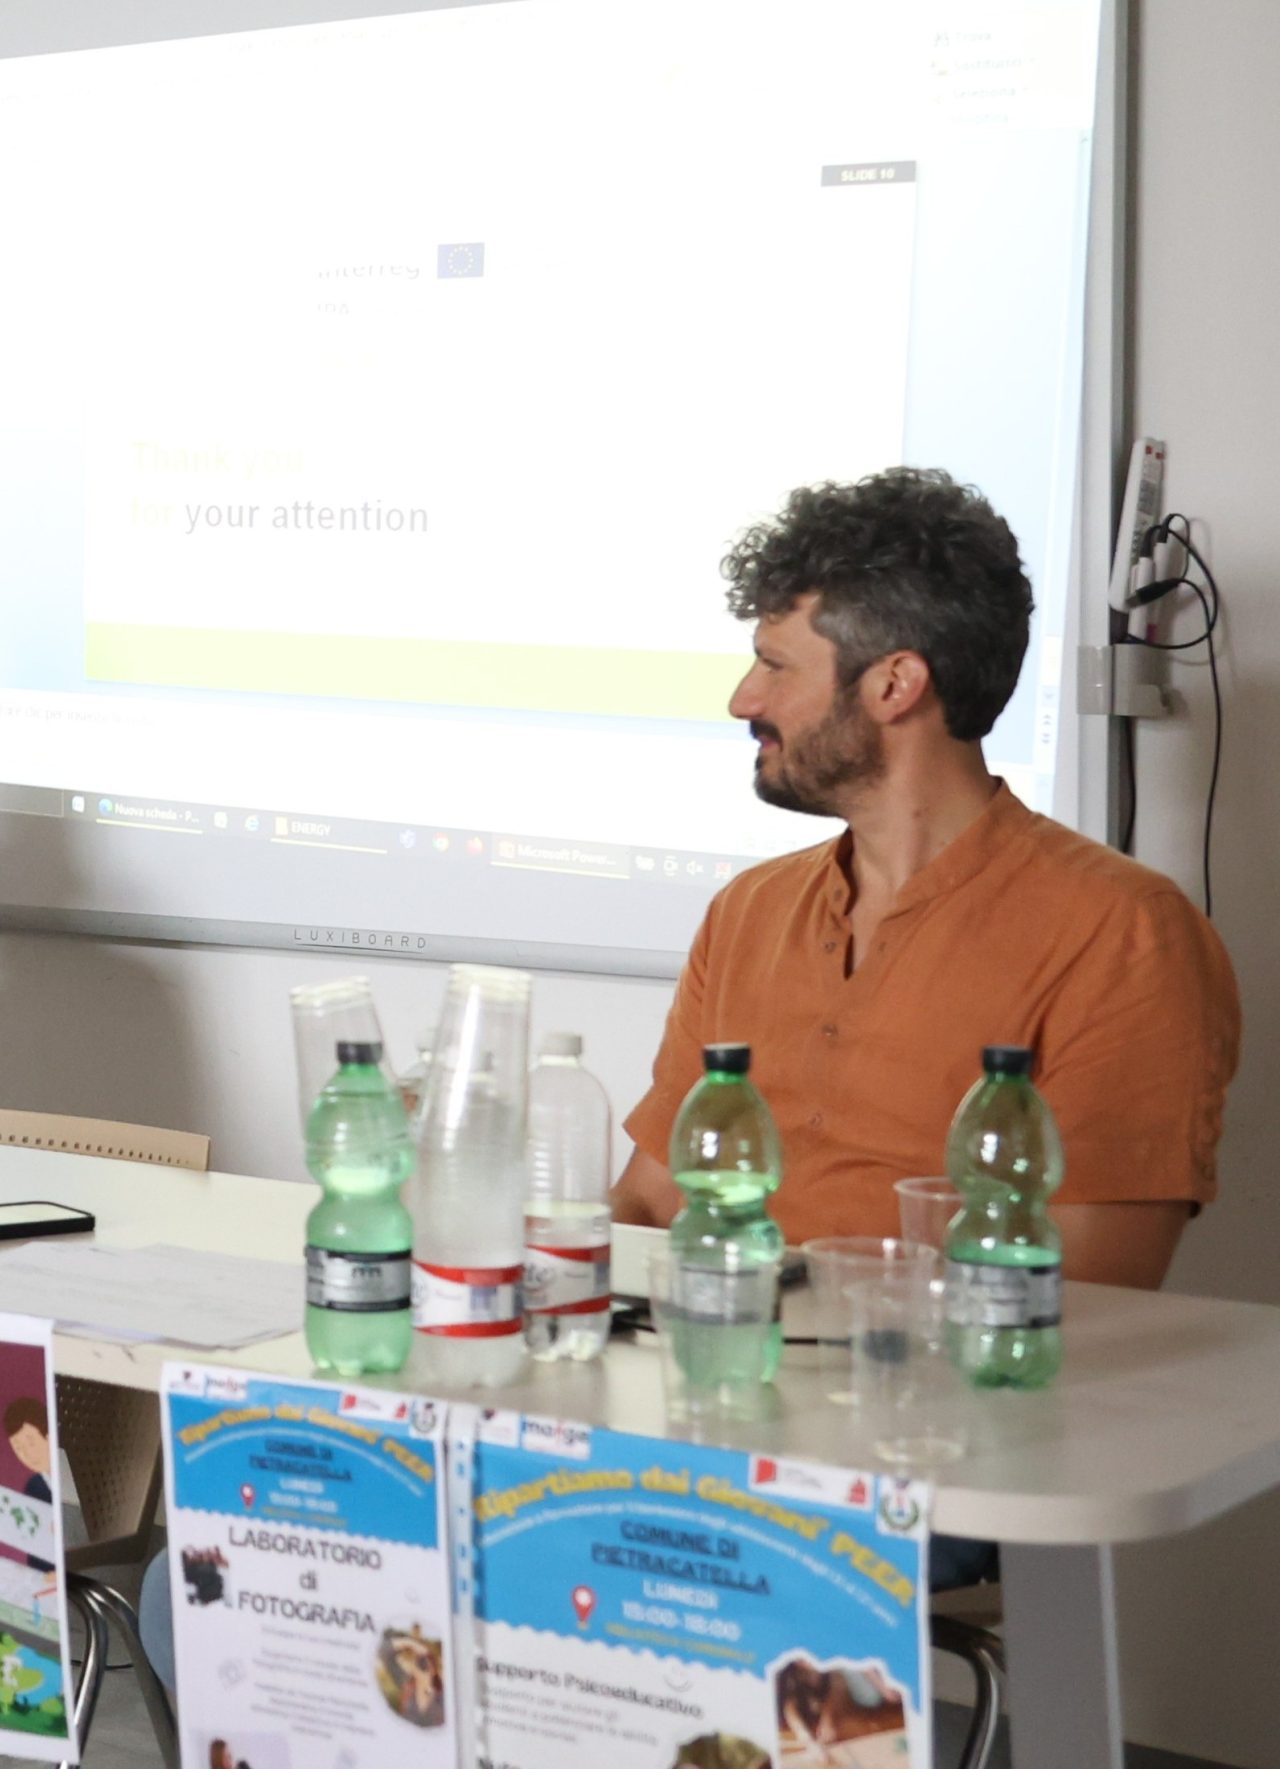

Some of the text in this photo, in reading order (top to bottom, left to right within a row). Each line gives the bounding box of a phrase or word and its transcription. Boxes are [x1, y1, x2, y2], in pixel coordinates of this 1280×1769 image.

[841, 167, 878, 182] SLIDE
[186, 504, 260, 535] your
[272, 498, 429, 533] attention
[115, 802, 143, 819] Nuova
[145, 805, 177, 822] scheda
[291, 821, 331, 836] ENERGY
[517, 844, 569, 863] Microsoft
[293, 929, 427, 949] LUXIBOARD
[228, 1525, 382, 1570] LABORATORIO
[299, 1570, 317, 1591] di
[238, 1591, 376, 1633] FOTOGRAFIA
